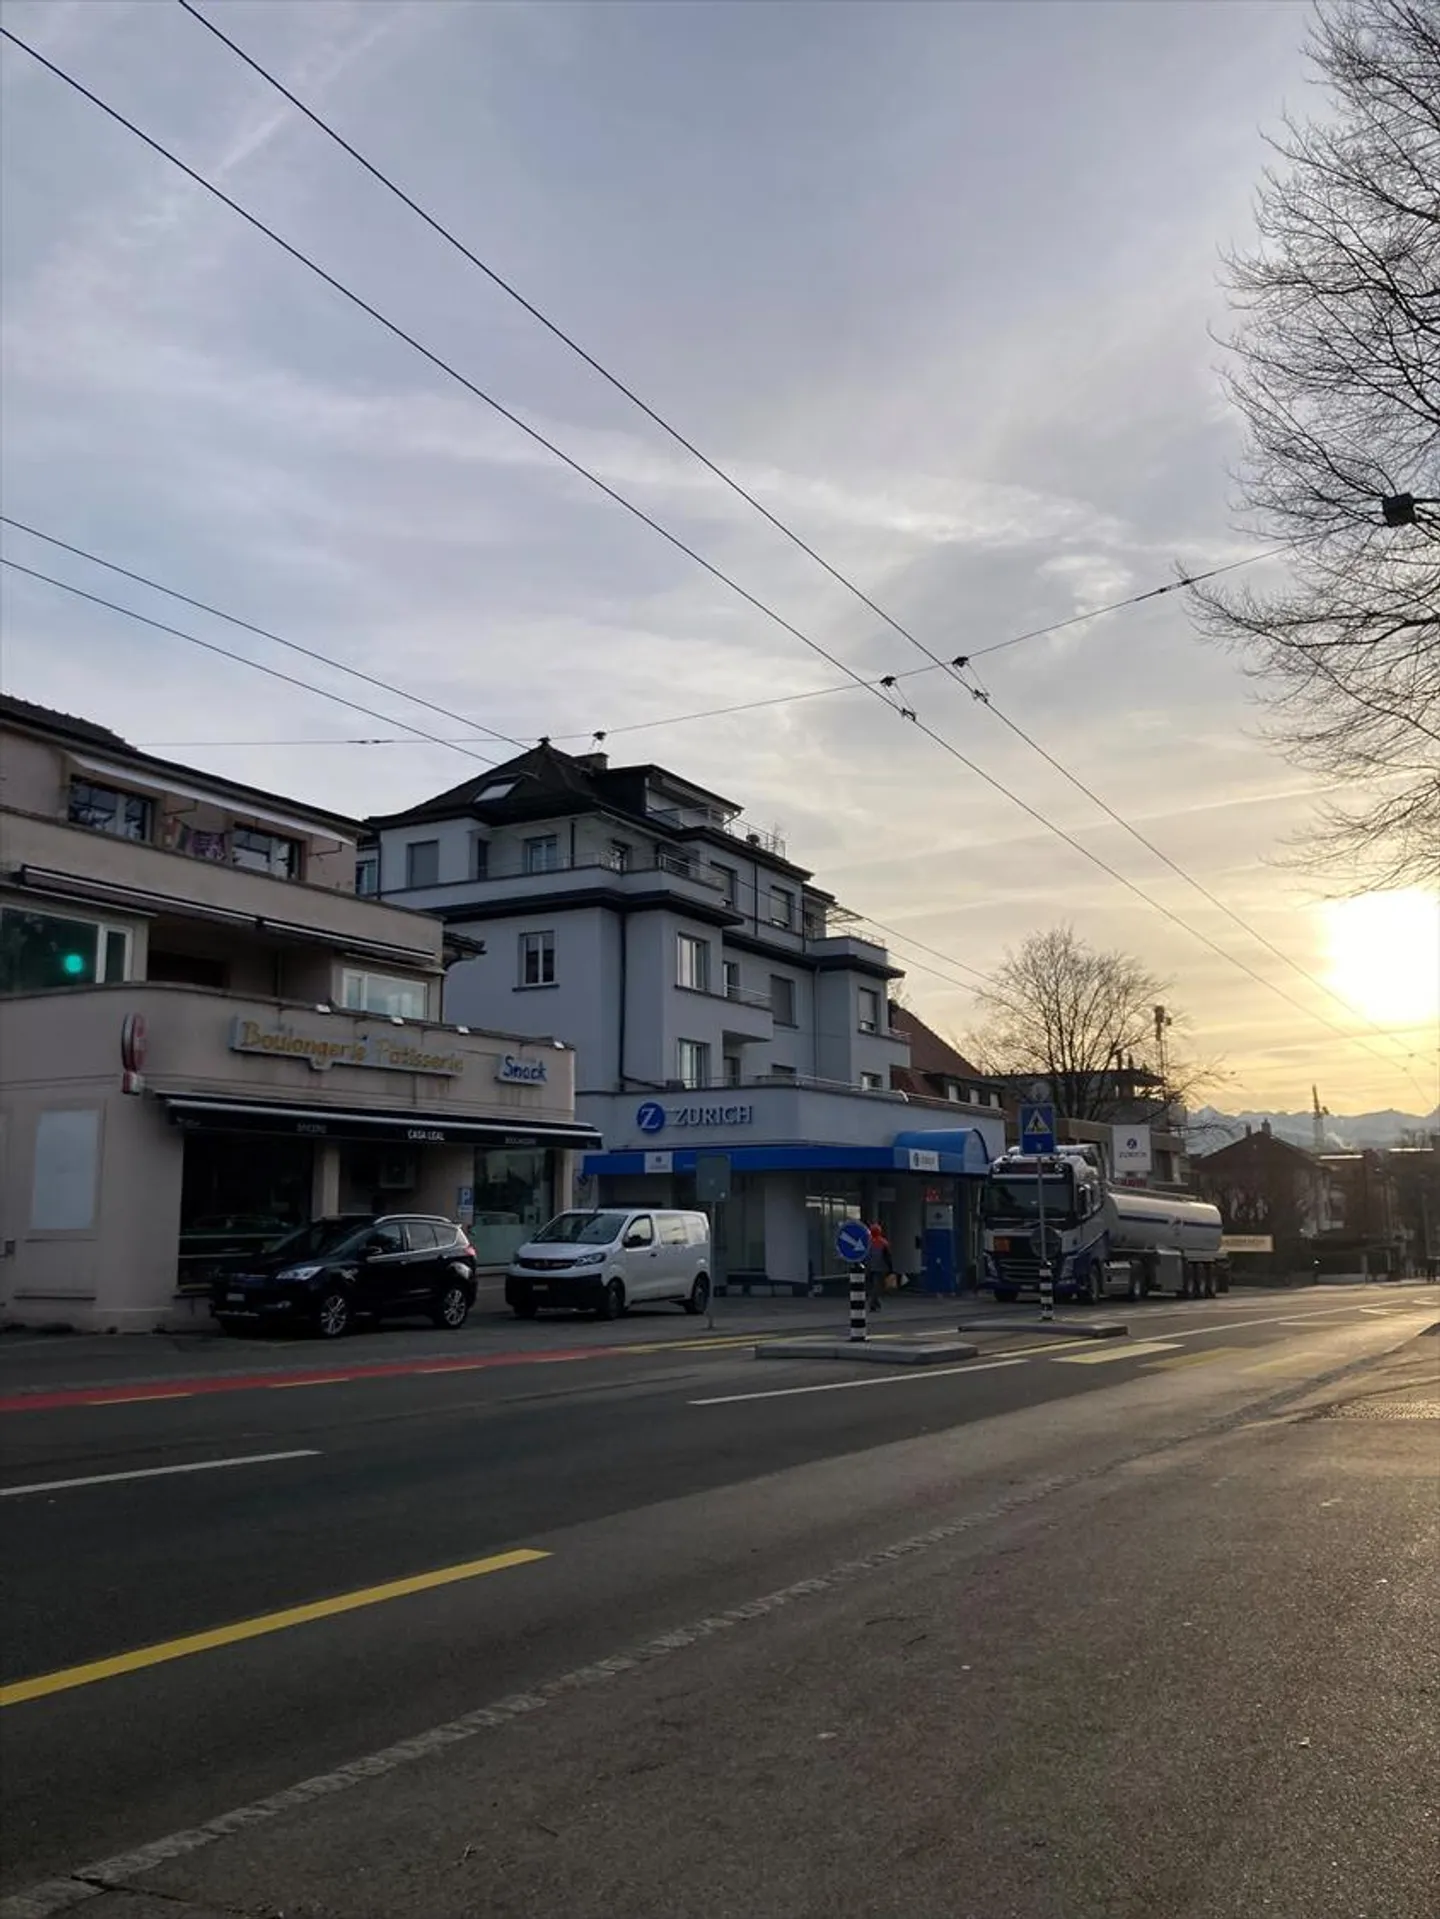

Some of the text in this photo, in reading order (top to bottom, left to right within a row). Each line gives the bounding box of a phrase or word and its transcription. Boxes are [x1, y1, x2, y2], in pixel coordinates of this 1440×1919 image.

[503, 1055, 548, 1082] Snack
[675, 1105, 753, 1126] ZURICH
[407, 1129, 426, 1139] CASA
